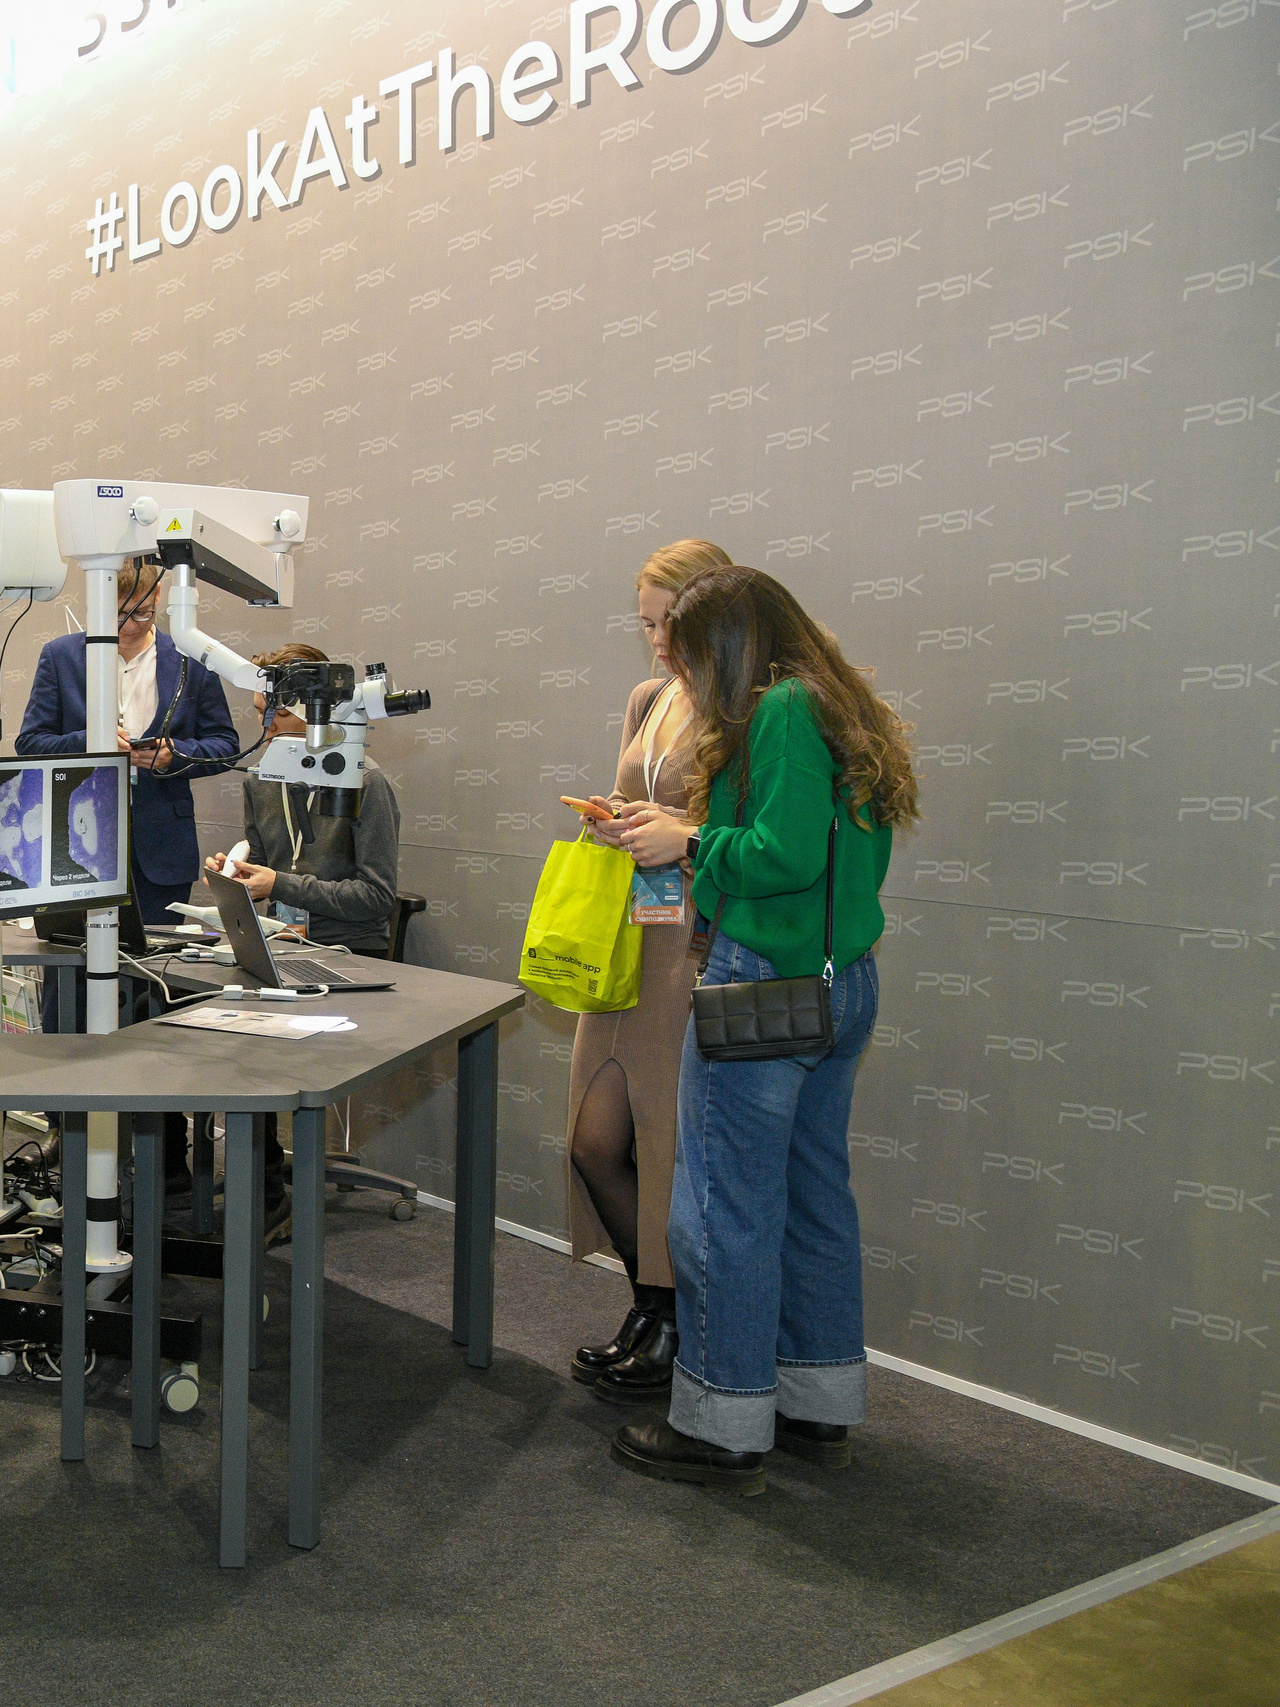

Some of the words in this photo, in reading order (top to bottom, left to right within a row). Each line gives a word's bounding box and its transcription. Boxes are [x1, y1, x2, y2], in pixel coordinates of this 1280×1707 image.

[847, 11, 921, 50] PSK
[913, 29, 992, 79] PSK
[702, 64, 766, 108] PSK
[985, 60, 1070, 112] PSK
[599, 110, 655, 150] PSK
[761, 93, 827, 137] PSK
[1062, 93, 1154, 146] PSK
[848, 114, 922, 160] PSK
[1182, 120, 1280, 172] PSK
[650, 138, 710, 179] PSK
[915, 147, 994, 194] PSK
[488, 160, 537, 196] PSK
[705, 169, 768, 210] PSK
[406, 197, 450, 230] PSK
[533, 187, 585, 224] PSK
[986, 184, 1071, 230] PSK
[600, 210, 657, 246] PSK
[762, 202, 829, 243] PSK
[447, 224, 493, 257] PSK
[849, 228, 923, 270] PSK
[1063, 221, 1155, 269] PSK
[489, 252, 538, 285] PSK
[652, 241, 711, 278] PSK
[706, 275, 769, 312] PSK
[916, 267, 994, 308] PSK
[1182, 256, 1280, 302] PSK
[408, 284, 452, 315] PSK
[534, 283, 586, 317] PSK
[448, 313, 495, 345] PSK
[602, 309, 658, 343] PSK
[764, 312, 830, 348] PSK
[987, 307, 1071, 349] PSK
[490, 346, 539, 376] PSK
[653, 344, 713, 378] PSK
[850, 343, 923, 381] PSK
[1063, 350, 1155, 392] PSK
[409, 372, 454, 401] PSK
[535, 379, 588, 410] PSK
[707, 382, 770, 415] PSK
[449, 404, 497, 433] PSK
[916, 385, 995, 423] PSK
[1182, 391, 1280, 432] PSK
[603, 409, 660, 440] PSK
[765, 421, 831, 455] PSK
[492, 438, 541, 467] PSK
[654, 447, 714, 478] PSK
[987, 430, 1072, 468] PSK
[411, 460, 456, 487] PSK
[537, 474, 589, 503] PSK
[851, 459, 924, 492] PSK
[451, 495, 498, 521] PSK
[708, 488, 771, 518] PSK
[1063, 478, 1155, 515] PSK
[604, 509, 661, 537] PSK
[917, 504, 995, 538] PSK
[412, 548, 457, 573] PSK
[493, 532, 543, 558] PSK
[766, 531, 830, 560] PSK
[1181, 526, 1280, 562] PSK
[538, 570, 590, 596] PSK
[987, 553, 1071, 586] PSK
[452, 586, 499, 610] PSK
[851, 573, 924, 603] PSK
[495, 626, 544, 648] PSK
[916, 624, 995, 653] PSK
[1063, 607, 1153, 638] PSK
[413, 638, 457, 659] PSK
[454, 677, 500, 698] PSK
[987, 678, 1071, 705] PSK
[1181, 663, 1277, 693] PSK
[54, 773, 67, 781] SOI
[454, 767, 501, 786] PSK
[539, 763, 591, 783] PSK
[582, 963, 602, 974] app
[983, 1034, 1068, 1064] PSK
[1176, 1051, 1276, 1084] PSK
[913, 1085, 989, 1115] PSK
[1057, 1102, 1148, 1135] PSK
[1055, 1223, 1144, 1260] PSK
[979, 1268, 1062, 1305] PSK
[908, 1310, 985, 1347] PSK
[1053, 1343, 1143, 1385] PSK
